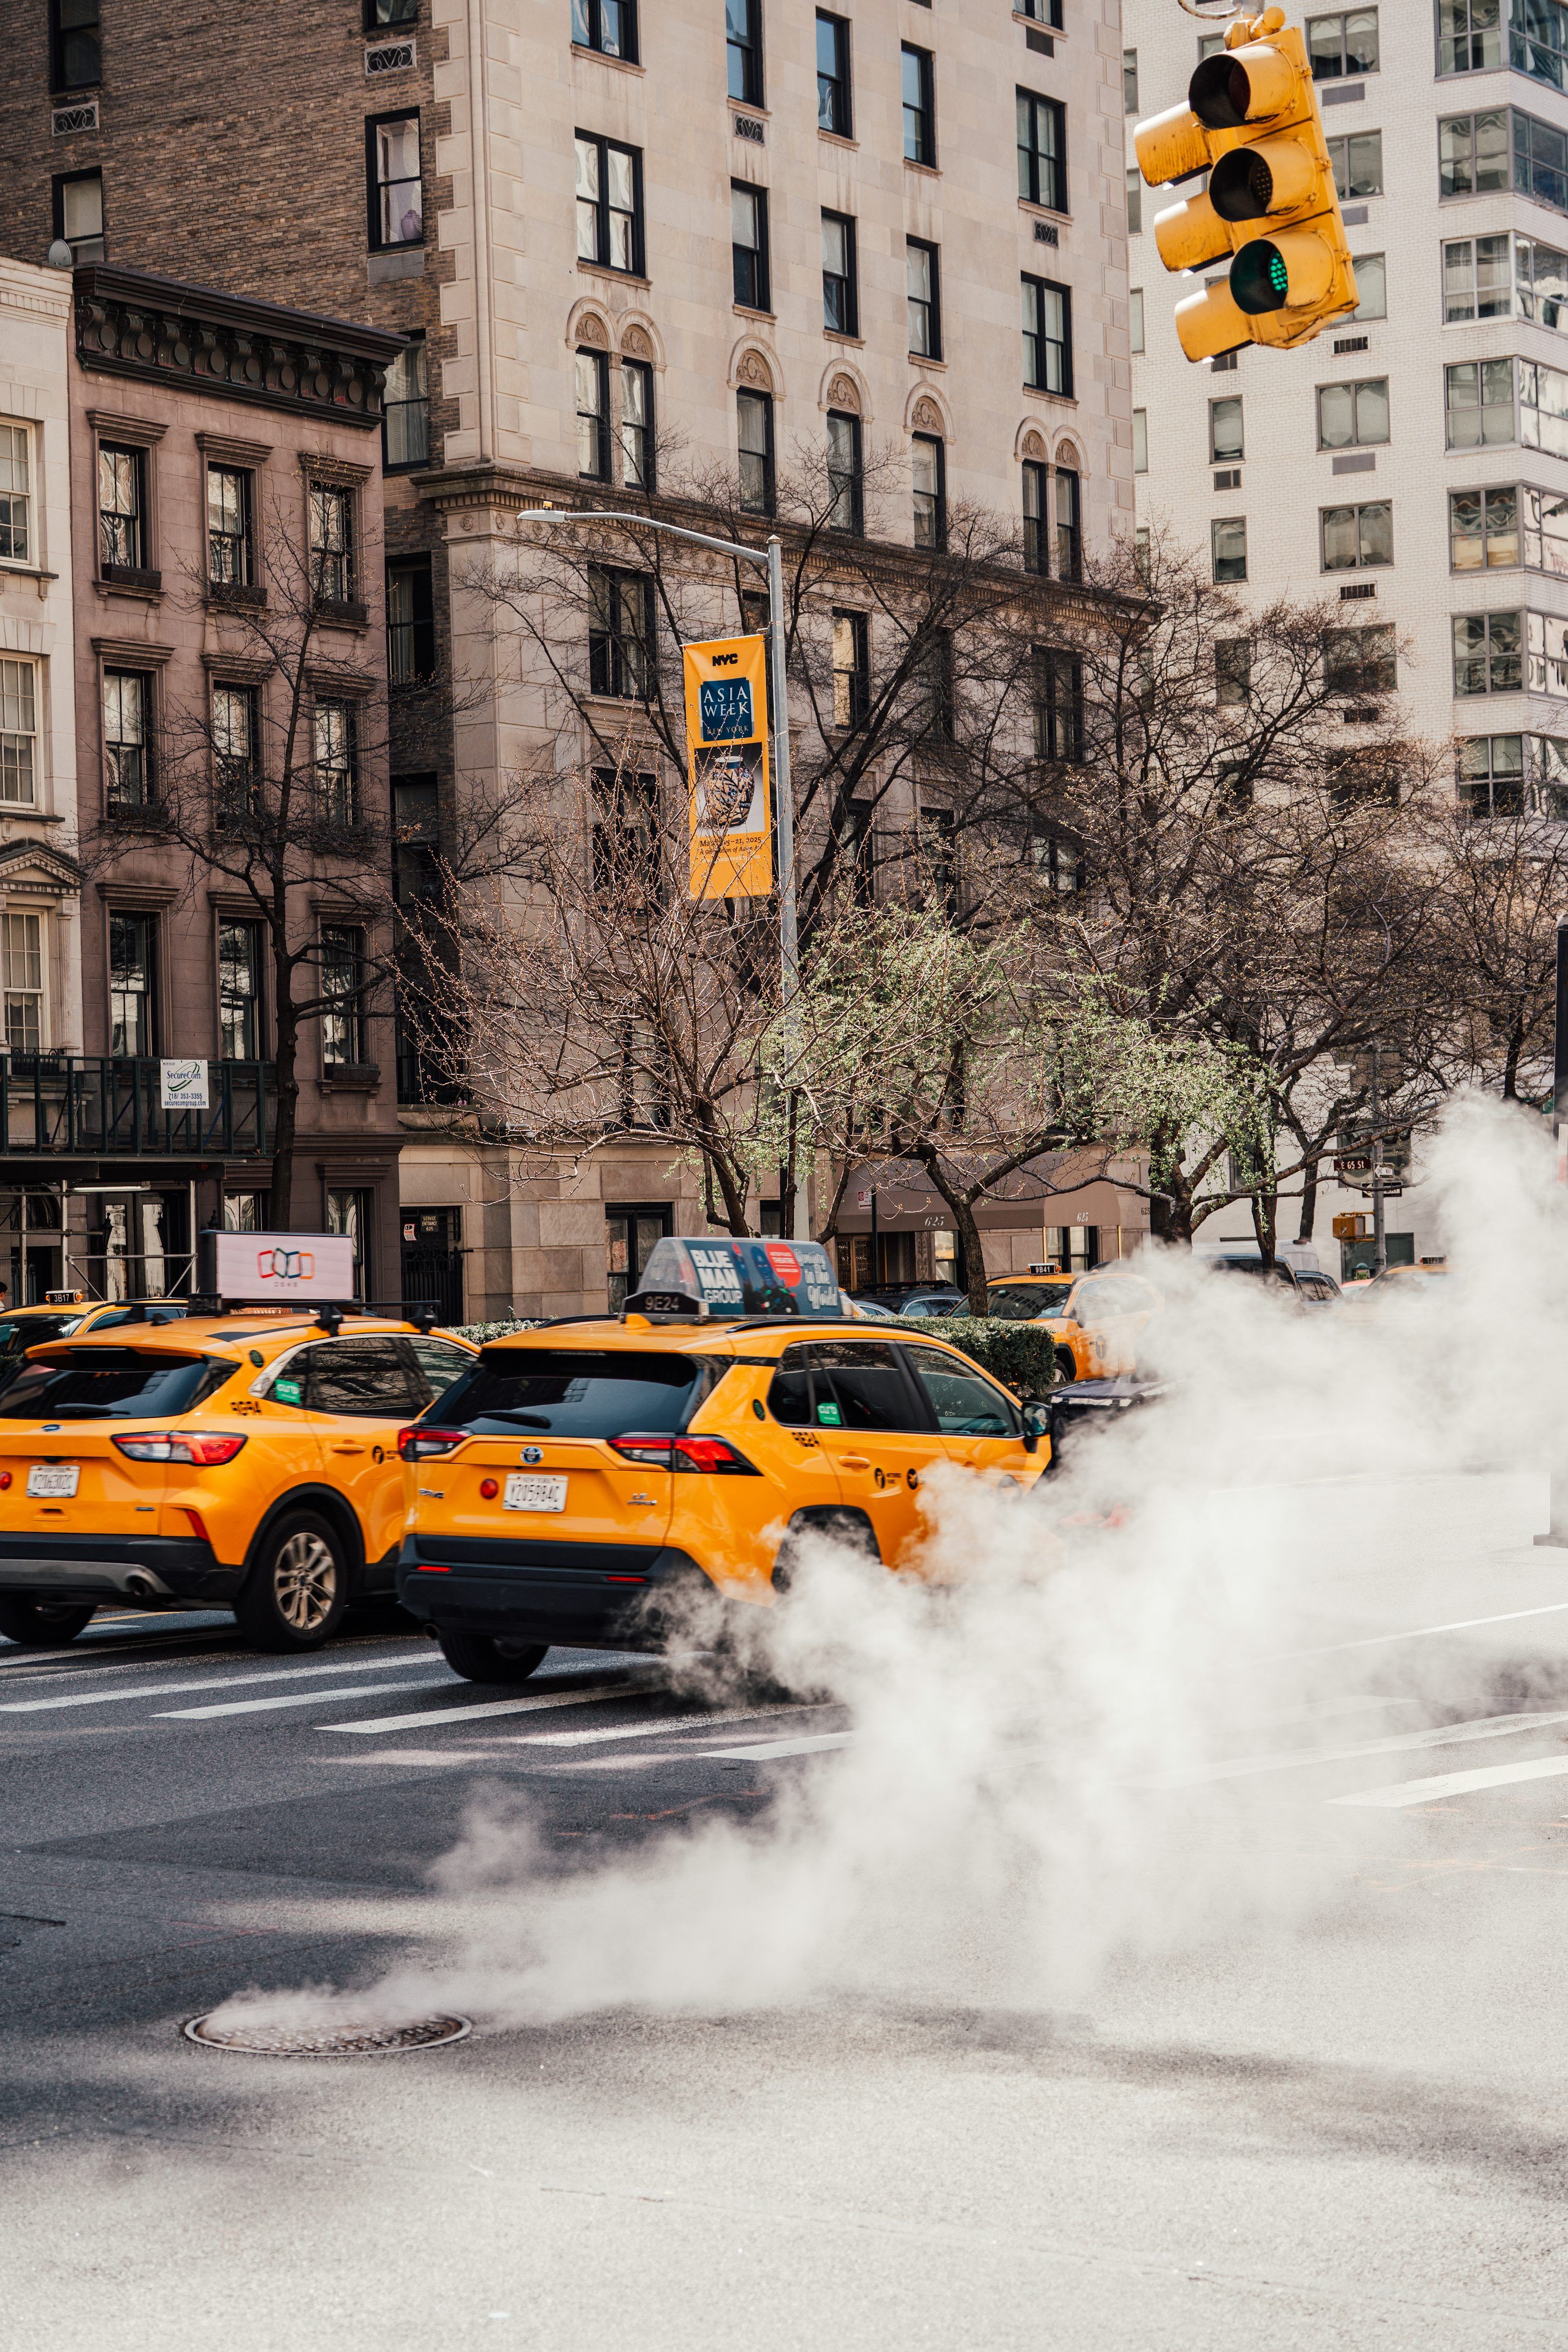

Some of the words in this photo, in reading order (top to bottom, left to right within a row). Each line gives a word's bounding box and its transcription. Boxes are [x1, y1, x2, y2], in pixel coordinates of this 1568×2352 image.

[712, 653, 738, 666] NYC
[703, 686, 748, 703] ASIA
[704, 701, 750, 717] WEEK
[167, 1070, 201, 1079] SecureCom
[1347, 1161, 1355, 1170] 65
[1357, 1160, 1364, 1169] St
[925, 1216, 945, 1227] 625
[1077, 1212, 1089, 1222] 625
[689, 1249, 735, 1268] BLUE
[697, 1268, 741, 1289] MAN
[54, 1294, 70, 1302] 3B17
[645, 1295, 679, 1311] 9E24
[704, 1289, 743, 1304] GROUP
